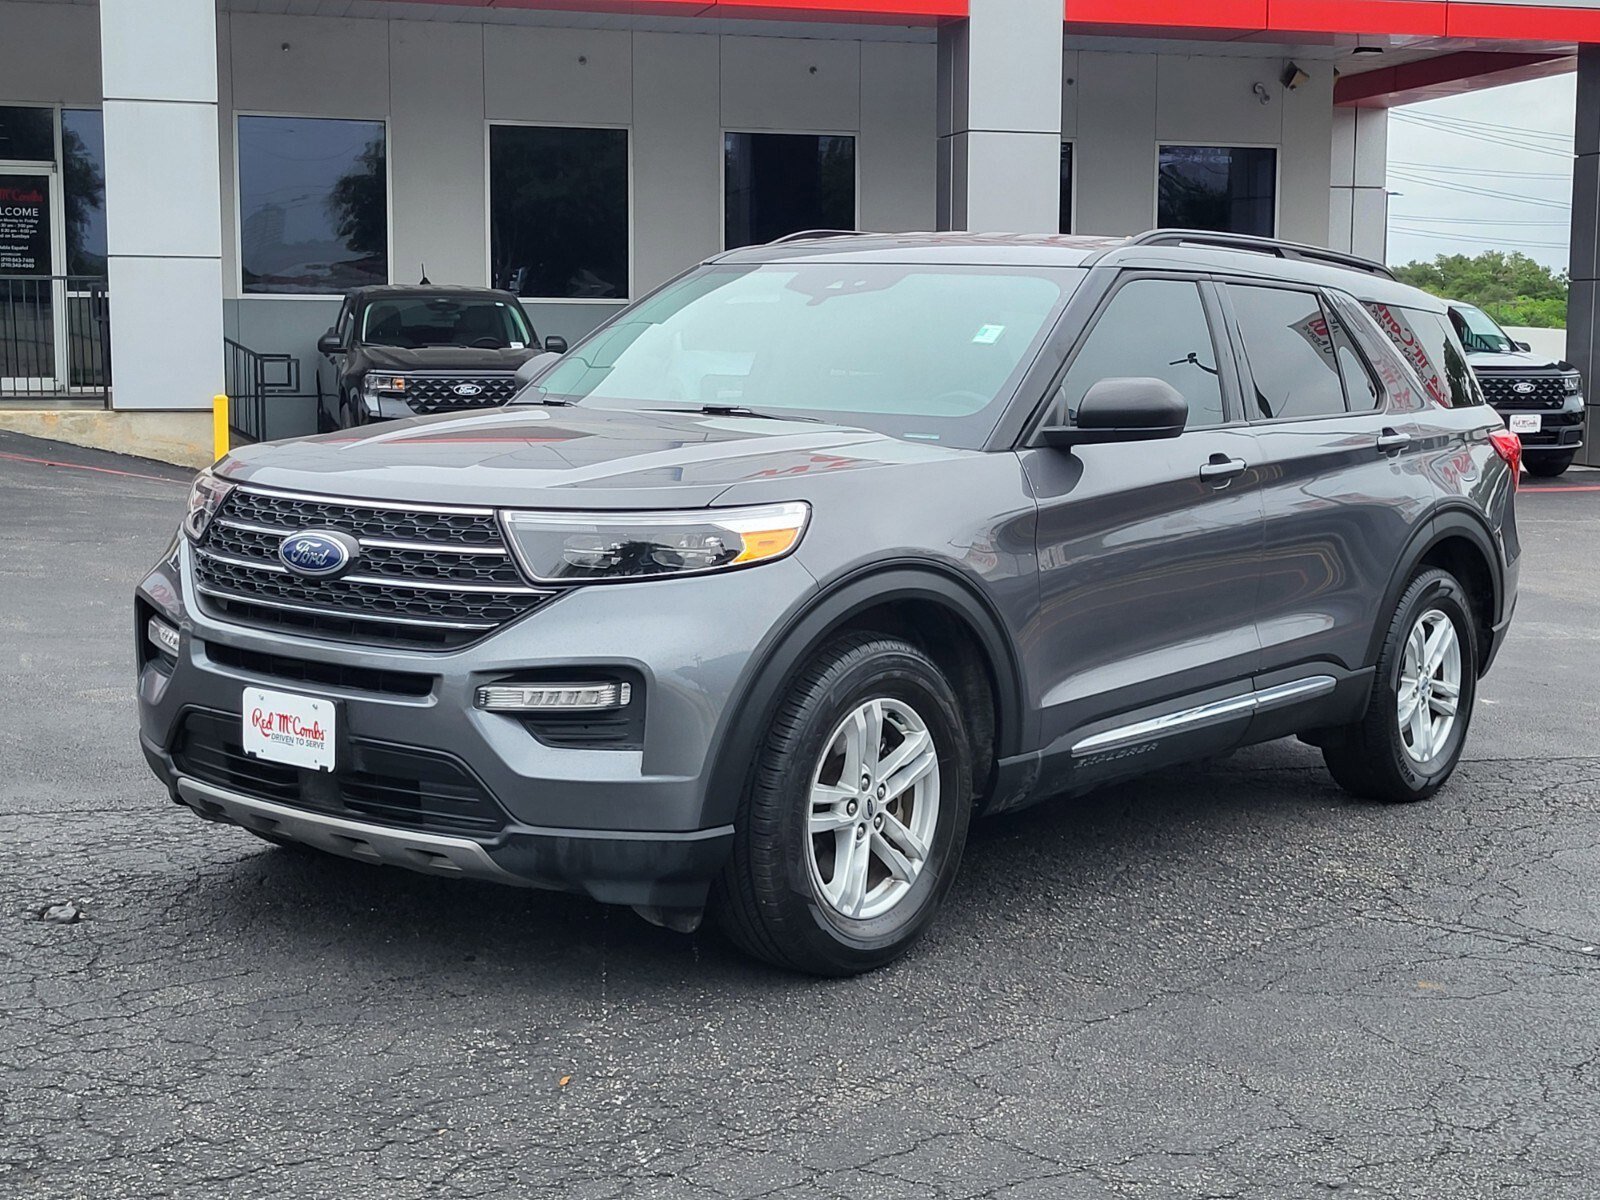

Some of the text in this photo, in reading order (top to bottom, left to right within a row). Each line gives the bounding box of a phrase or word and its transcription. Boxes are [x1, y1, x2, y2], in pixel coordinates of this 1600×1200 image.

[290, 540, 330, 566] Ford
[252, 707, 273, 738] Red
[270, 732, 325, 750] DRIVEN TO SERVE
